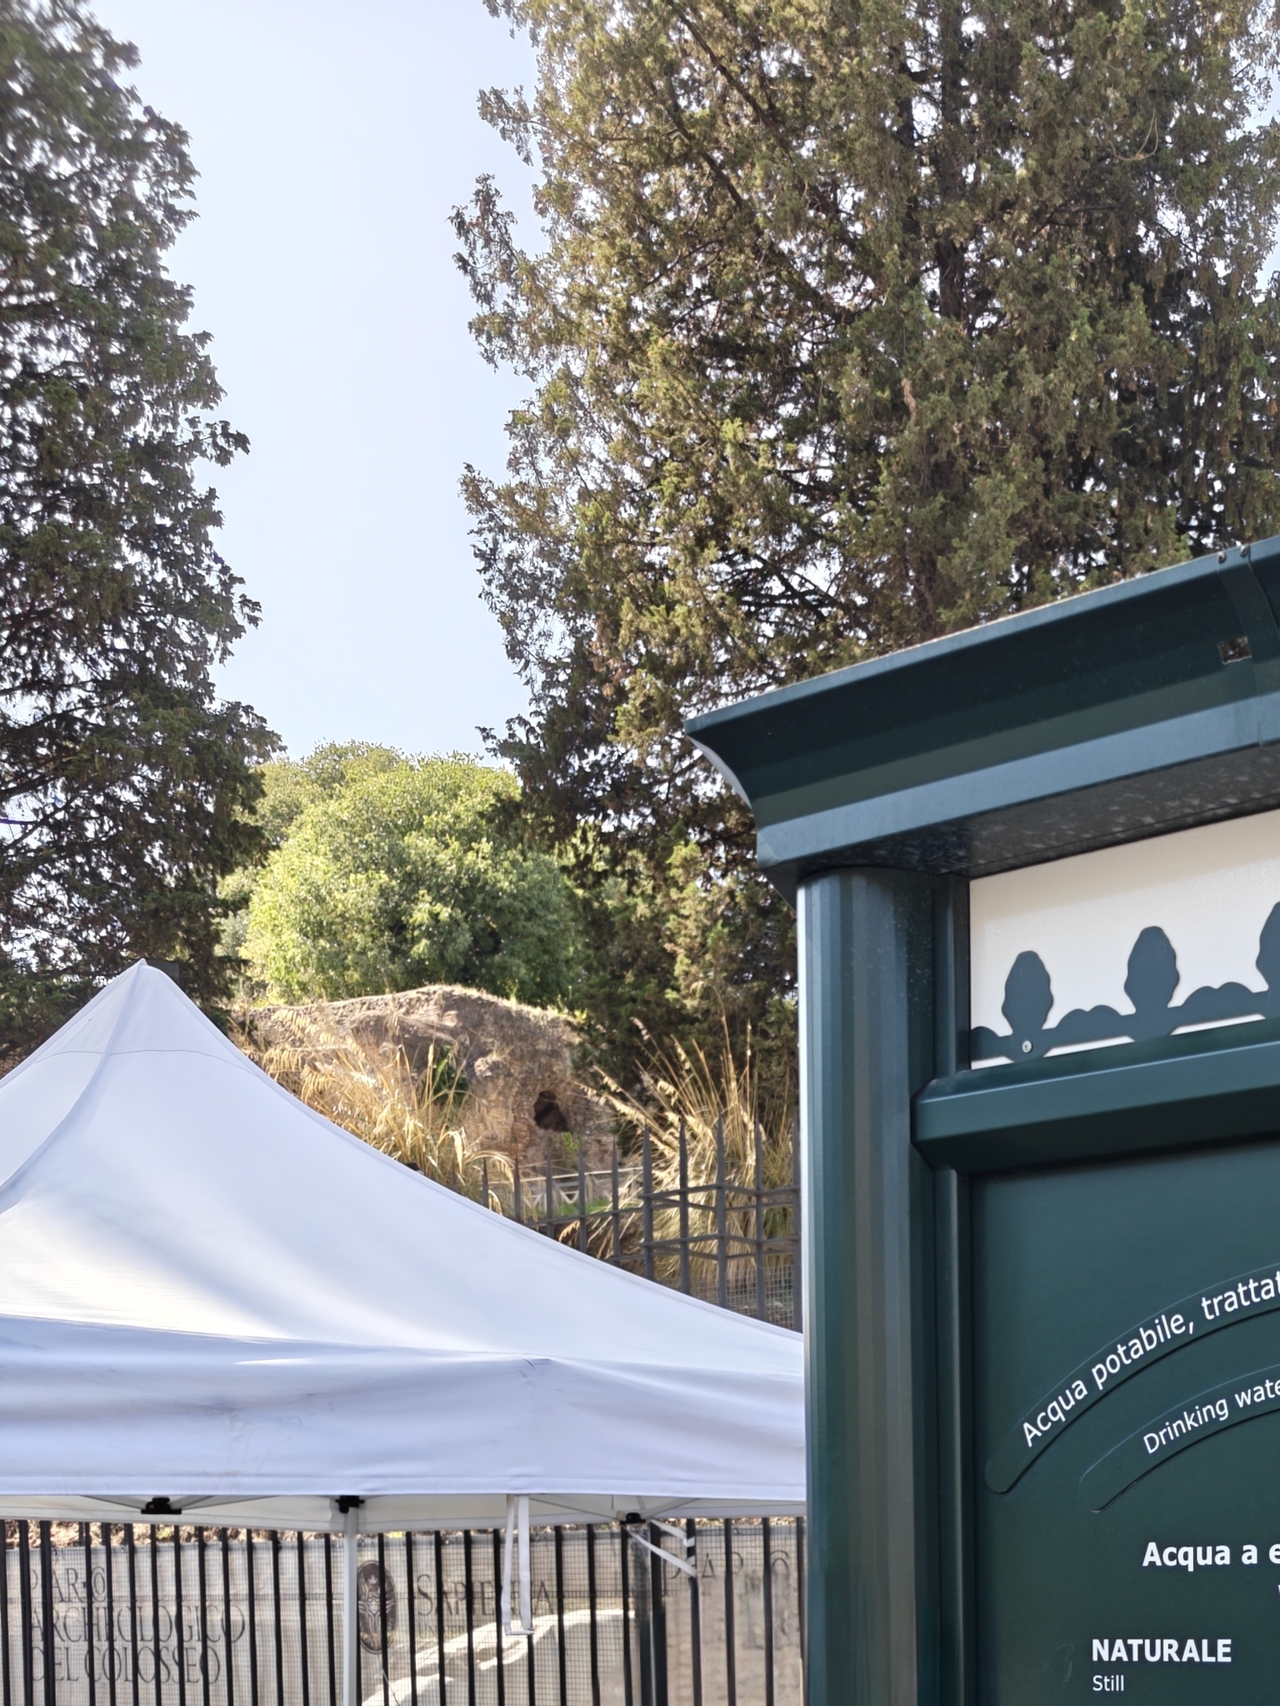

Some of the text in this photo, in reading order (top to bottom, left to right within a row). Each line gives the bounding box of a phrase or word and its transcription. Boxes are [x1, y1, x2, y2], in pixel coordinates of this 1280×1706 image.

[1022, 1379, 1089, 1448] Acqua
[1091, 1313, 1194, 1386] potabile,
[1143, 1398, 1229, 1454] Drinking
[1142, 1541, 1231, 1573] Acqua
[1241, 1544, 1258, 1565] a
[1092, 1638, 1232, 1663] NATURALE
[1092, 1674, 1125, 1692] Still
